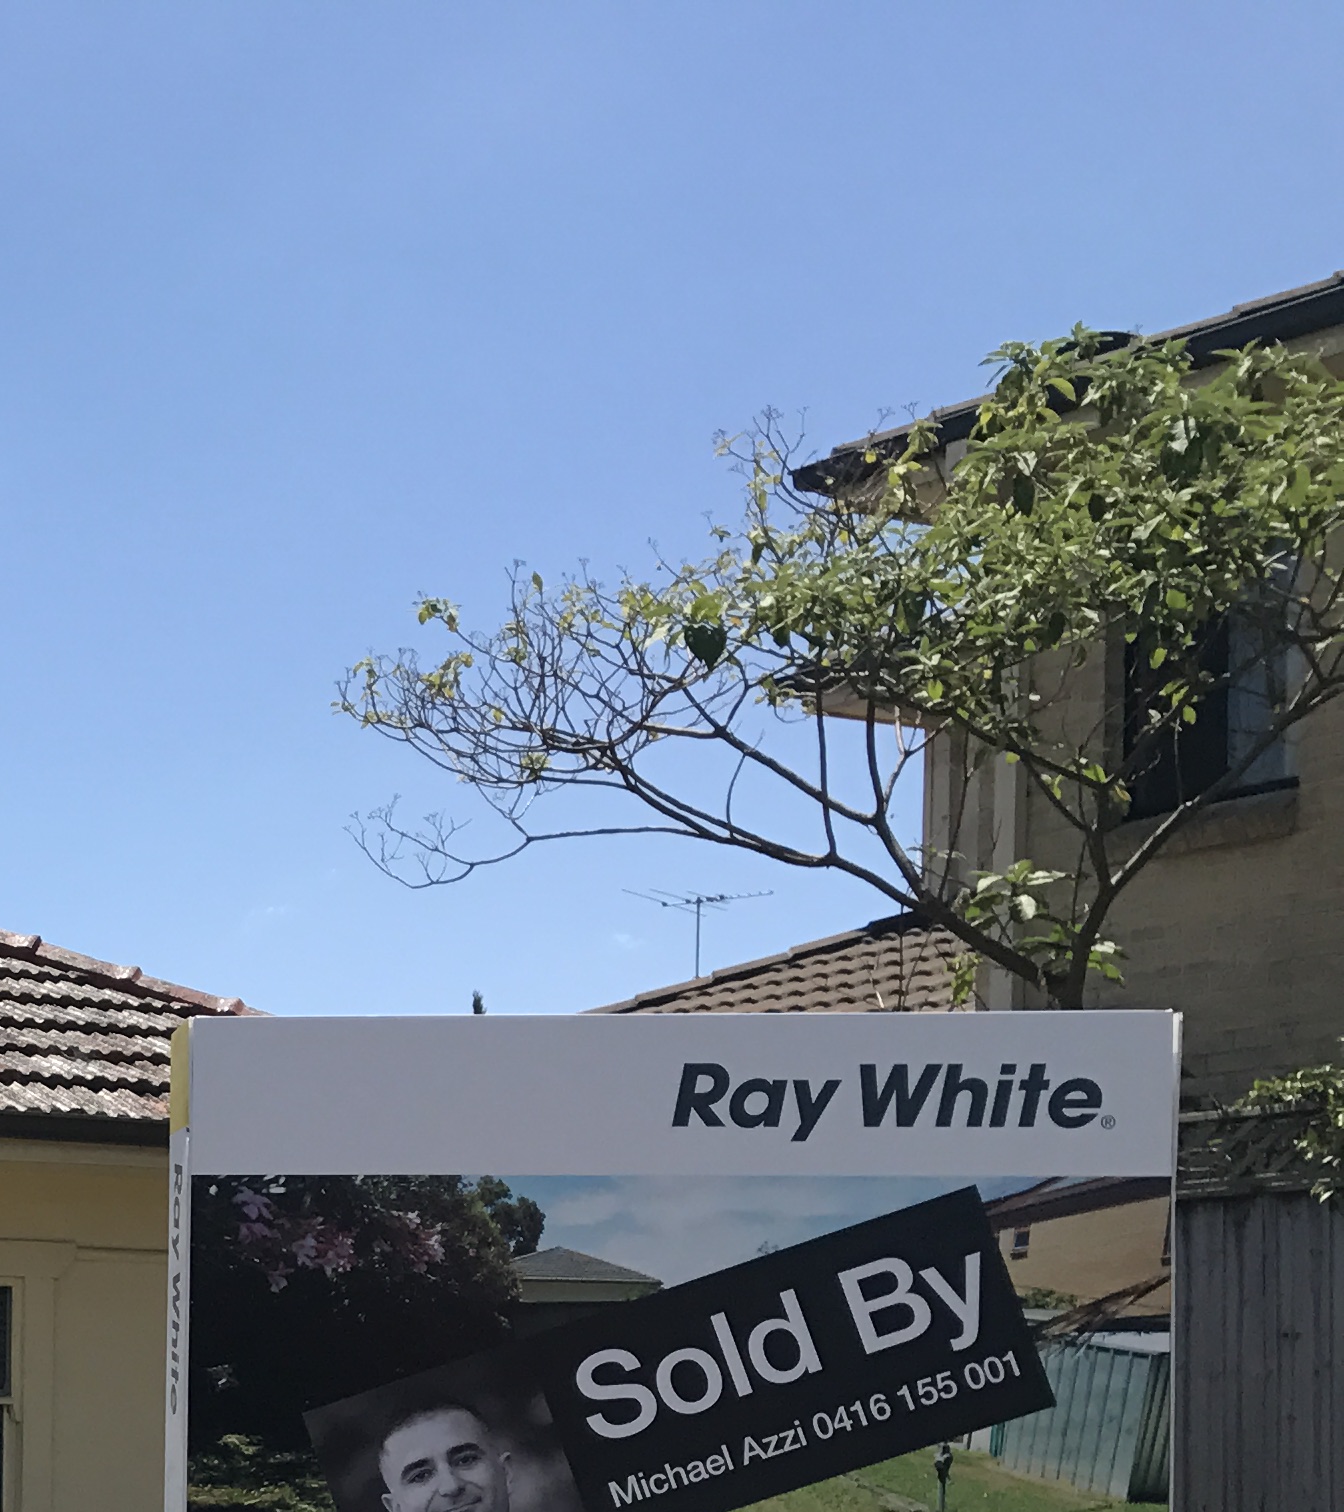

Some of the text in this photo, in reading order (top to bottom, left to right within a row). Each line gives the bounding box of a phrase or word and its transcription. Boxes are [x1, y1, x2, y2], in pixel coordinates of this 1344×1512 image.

[672, 1062, 842, 1142] Ray
[171, 1163, 183, 1261] Ray
[575, 1251, 982, 1439] Sold By
[607, 1350, 1021, 1509] Michael Azzi 0416 155 001
